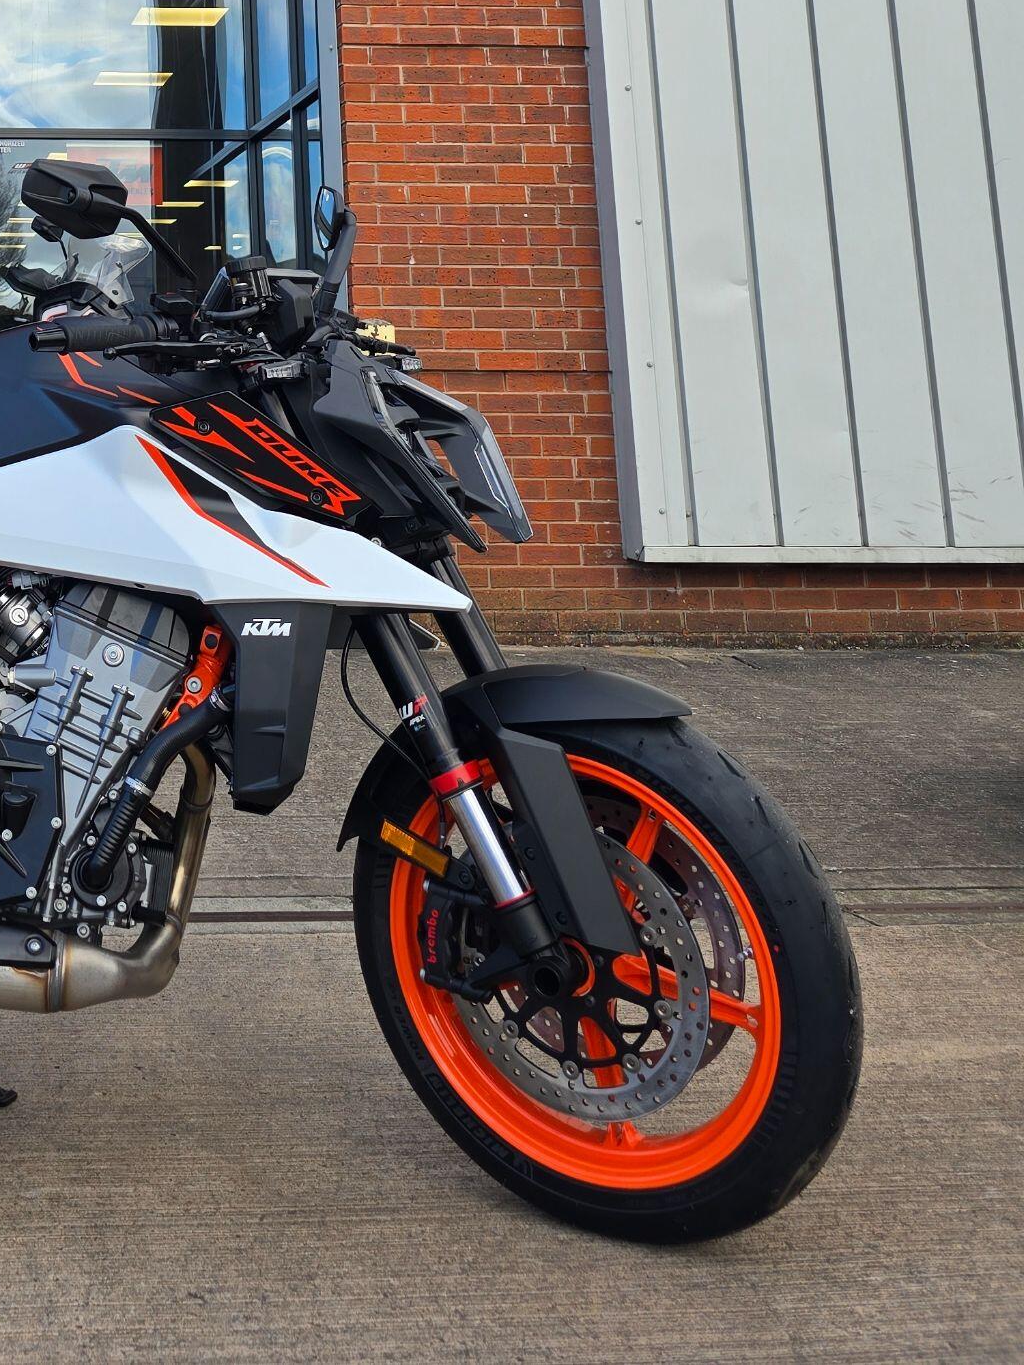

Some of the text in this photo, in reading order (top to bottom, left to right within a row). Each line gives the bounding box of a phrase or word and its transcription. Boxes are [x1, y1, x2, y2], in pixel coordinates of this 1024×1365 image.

[242, 420, 352, 500] DUKE
[240, 618, 292, 637] KTM
[426, 908, 439, 964] brembo
